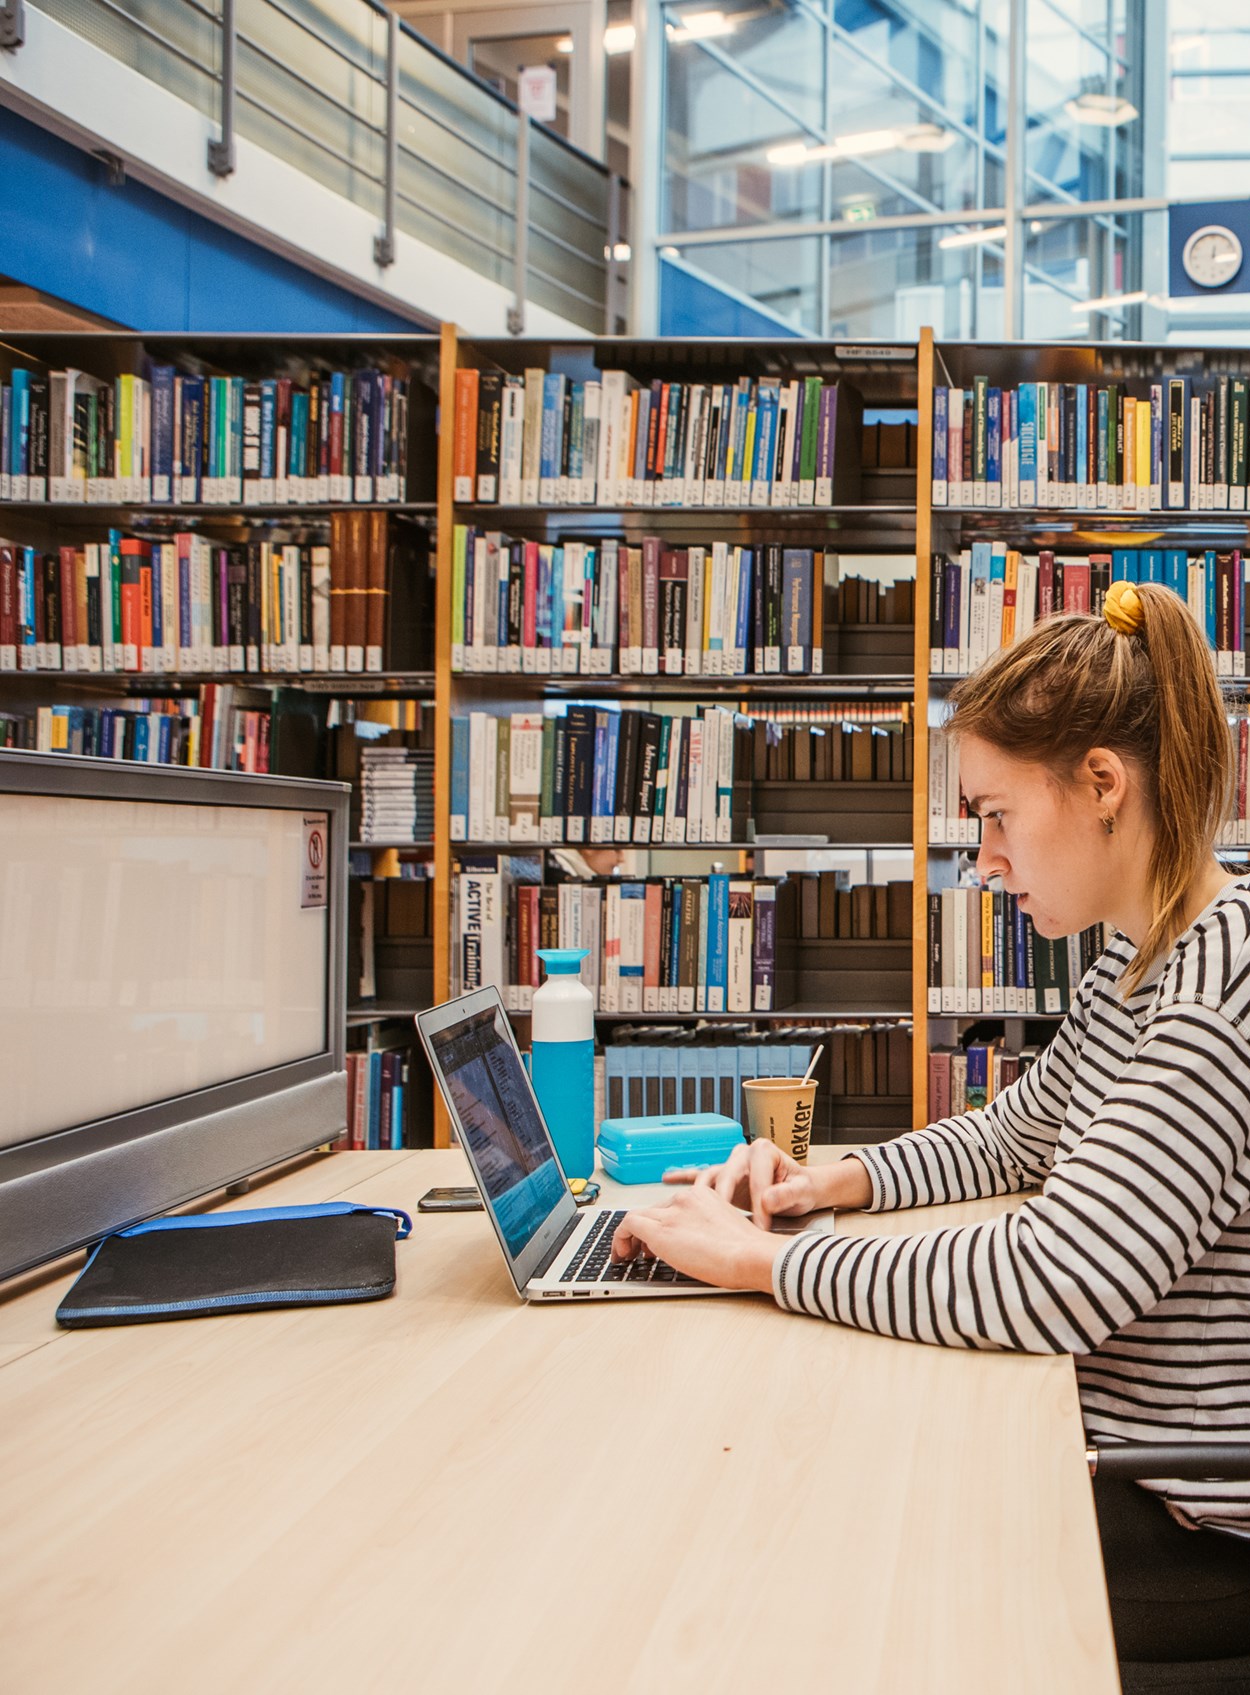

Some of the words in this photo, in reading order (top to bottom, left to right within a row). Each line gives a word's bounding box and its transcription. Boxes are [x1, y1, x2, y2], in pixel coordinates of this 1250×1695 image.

[1021, 422, 1034, 465] SOCIOLOGIE
[791, 578, 802, 612] Performance
[643, 743, 656, 779] Adverse
[690, 732, 702, 764] SMART
[568, 775, 577, 813] SELECTION
[640, 781, 653, 811] Impact
[468, 880, 481, 931] ACTIVE
[486, 913, 493, 921] of
[717, 880, 725, 922] Management
[716, 923, 724, 955] Accounting
[464, 935, 480, 990] Training
[790, 1100, 812, 1162] lekker
